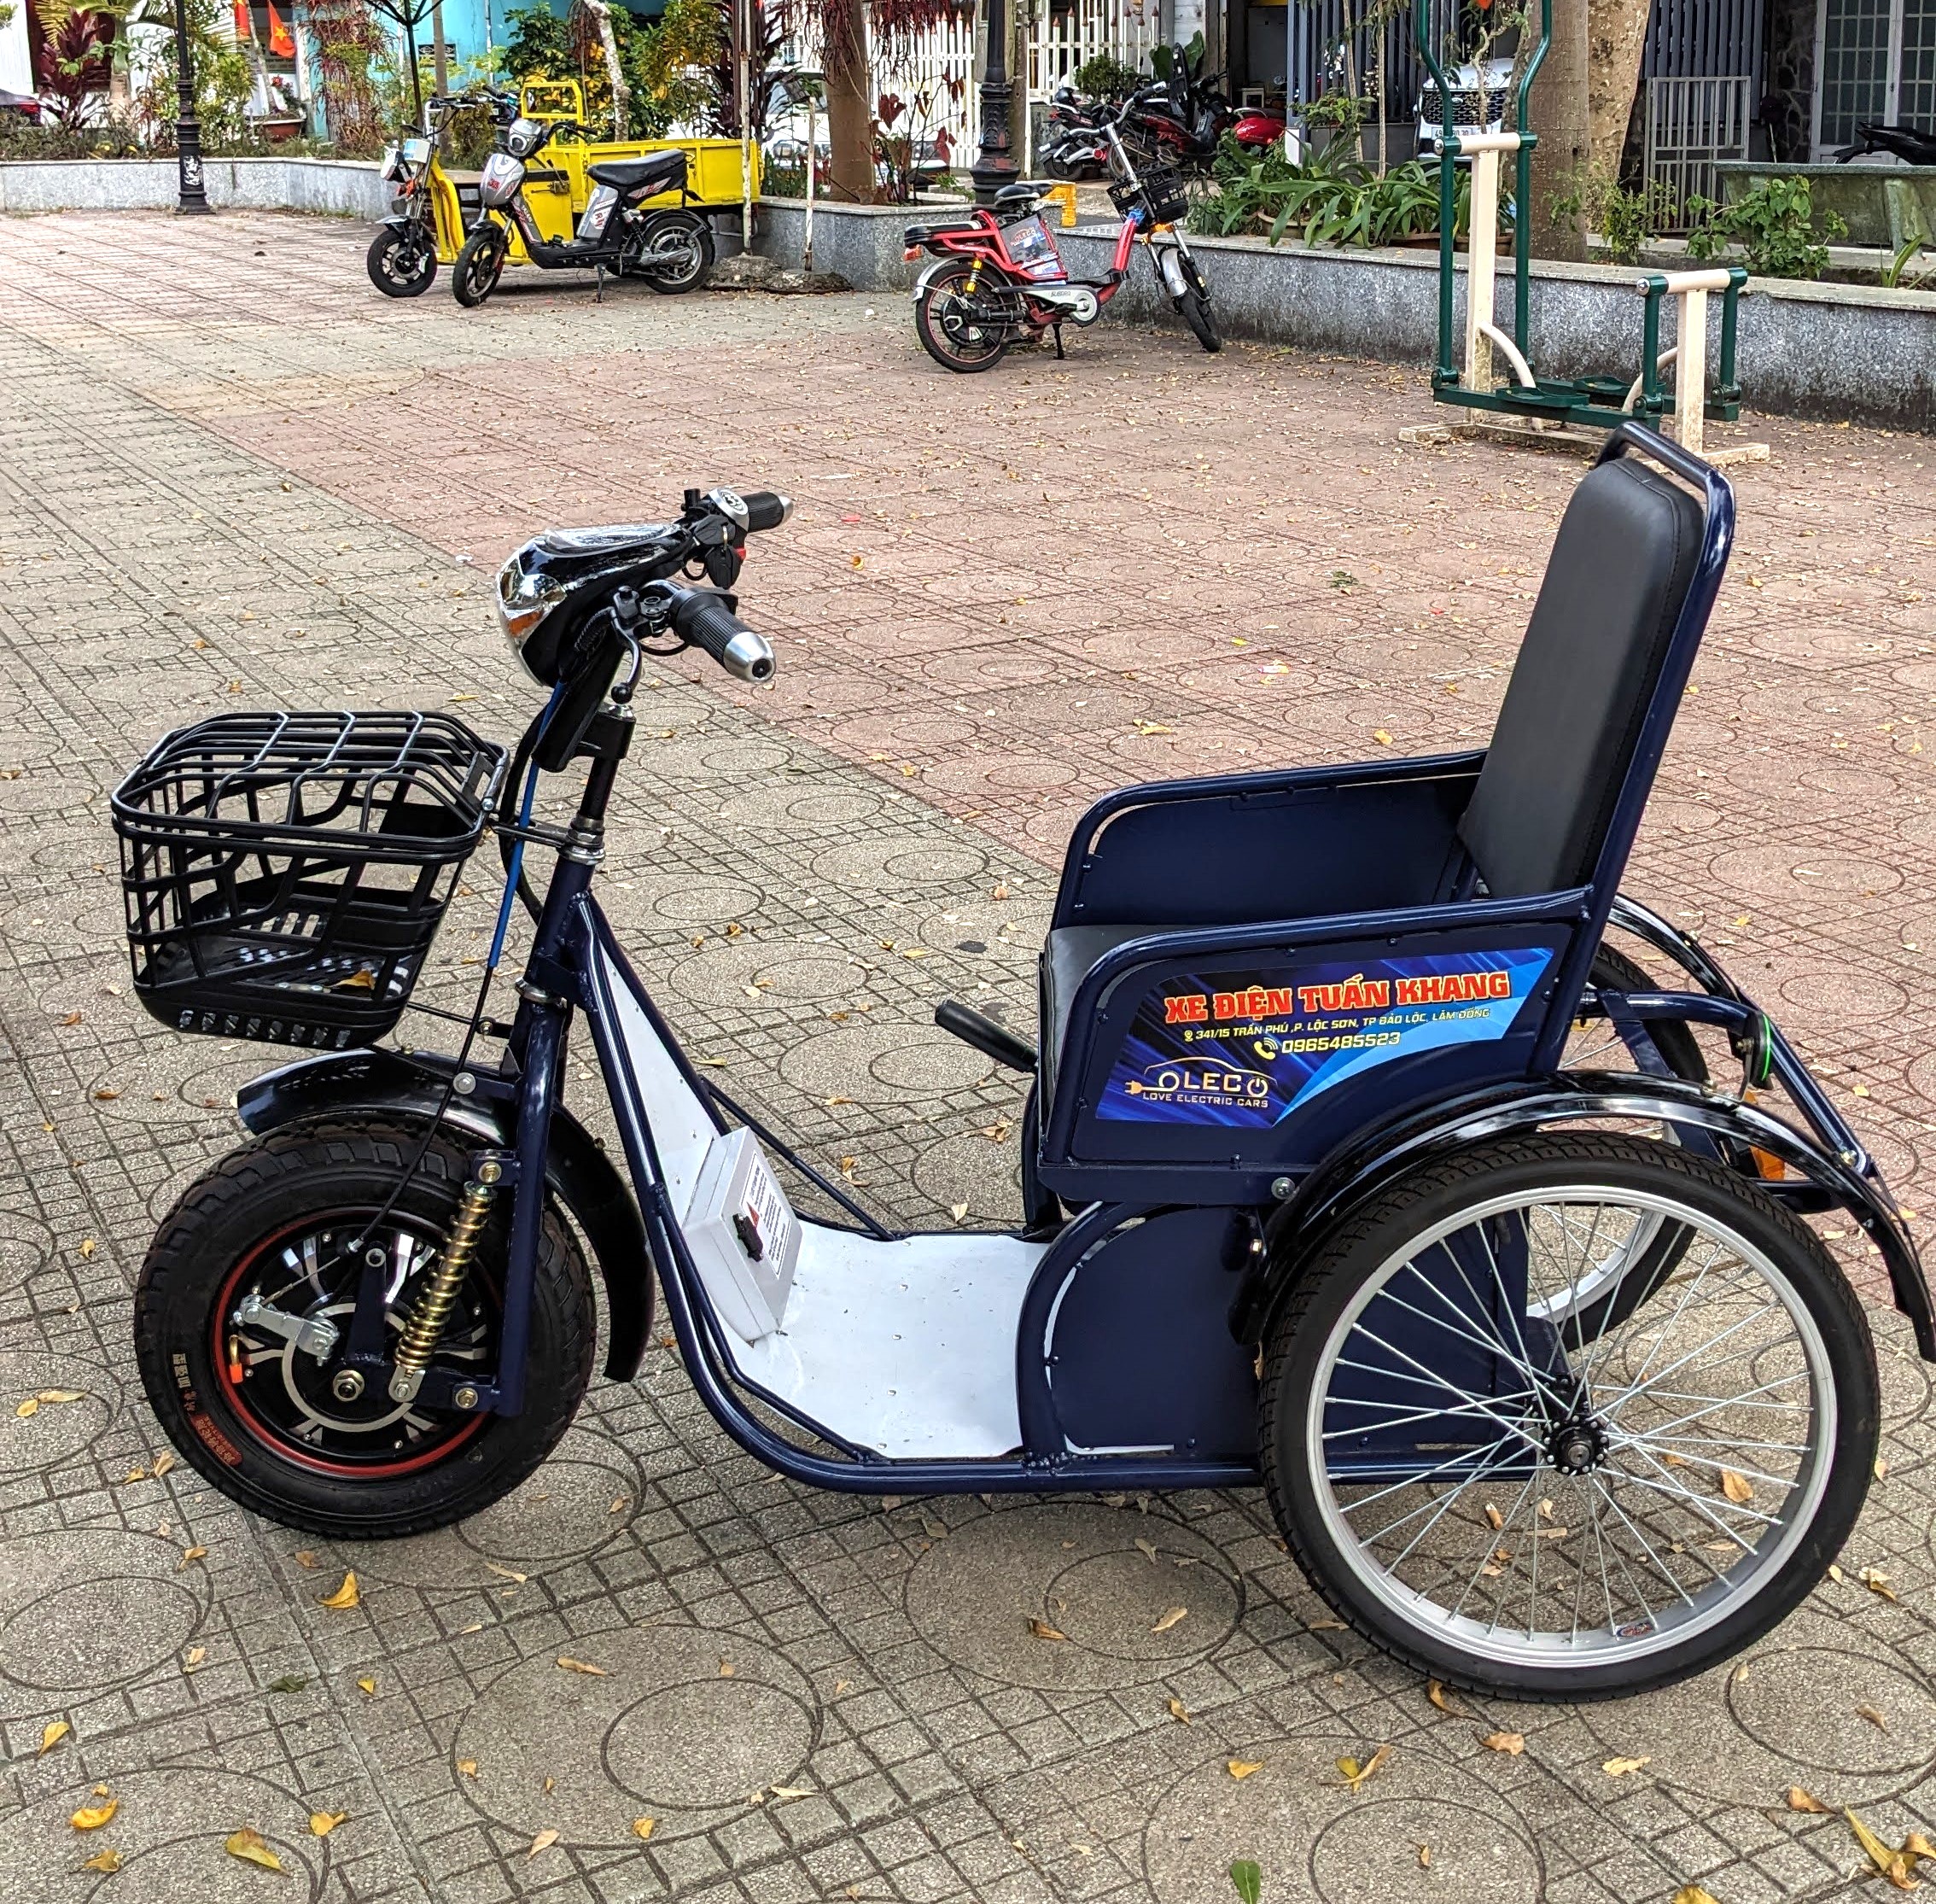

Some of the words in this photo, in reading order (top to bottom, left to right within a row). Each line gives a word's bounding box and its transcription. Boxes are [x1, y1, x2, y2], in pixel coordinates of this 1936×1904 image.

[1164, 995, 1209, 1024] XE
[1213, 985, 1293, 1021] ĐIỆN
[1298, 973, 1390, 1013] TUẤN
[1397, 972, 1510, 1005] KHANG
[1195, 1028, 1230, 1040] 341/15
[1265, 1022, 1289, 1034] PHÚ
[1308, 1019, 1329, 1033] LỘC
[1363, 1017, 1376, 1026] TP
[1432, 1009, 1455, 1021] LÂM
[1281, 1031, 1401, 1054] 0965485523
[1142, 1091, 1172, 1102] LOVE
[1176, 1094, 1233, 1106] ELECTRIC
[1236, 1097, 1269, 1108] CARS
